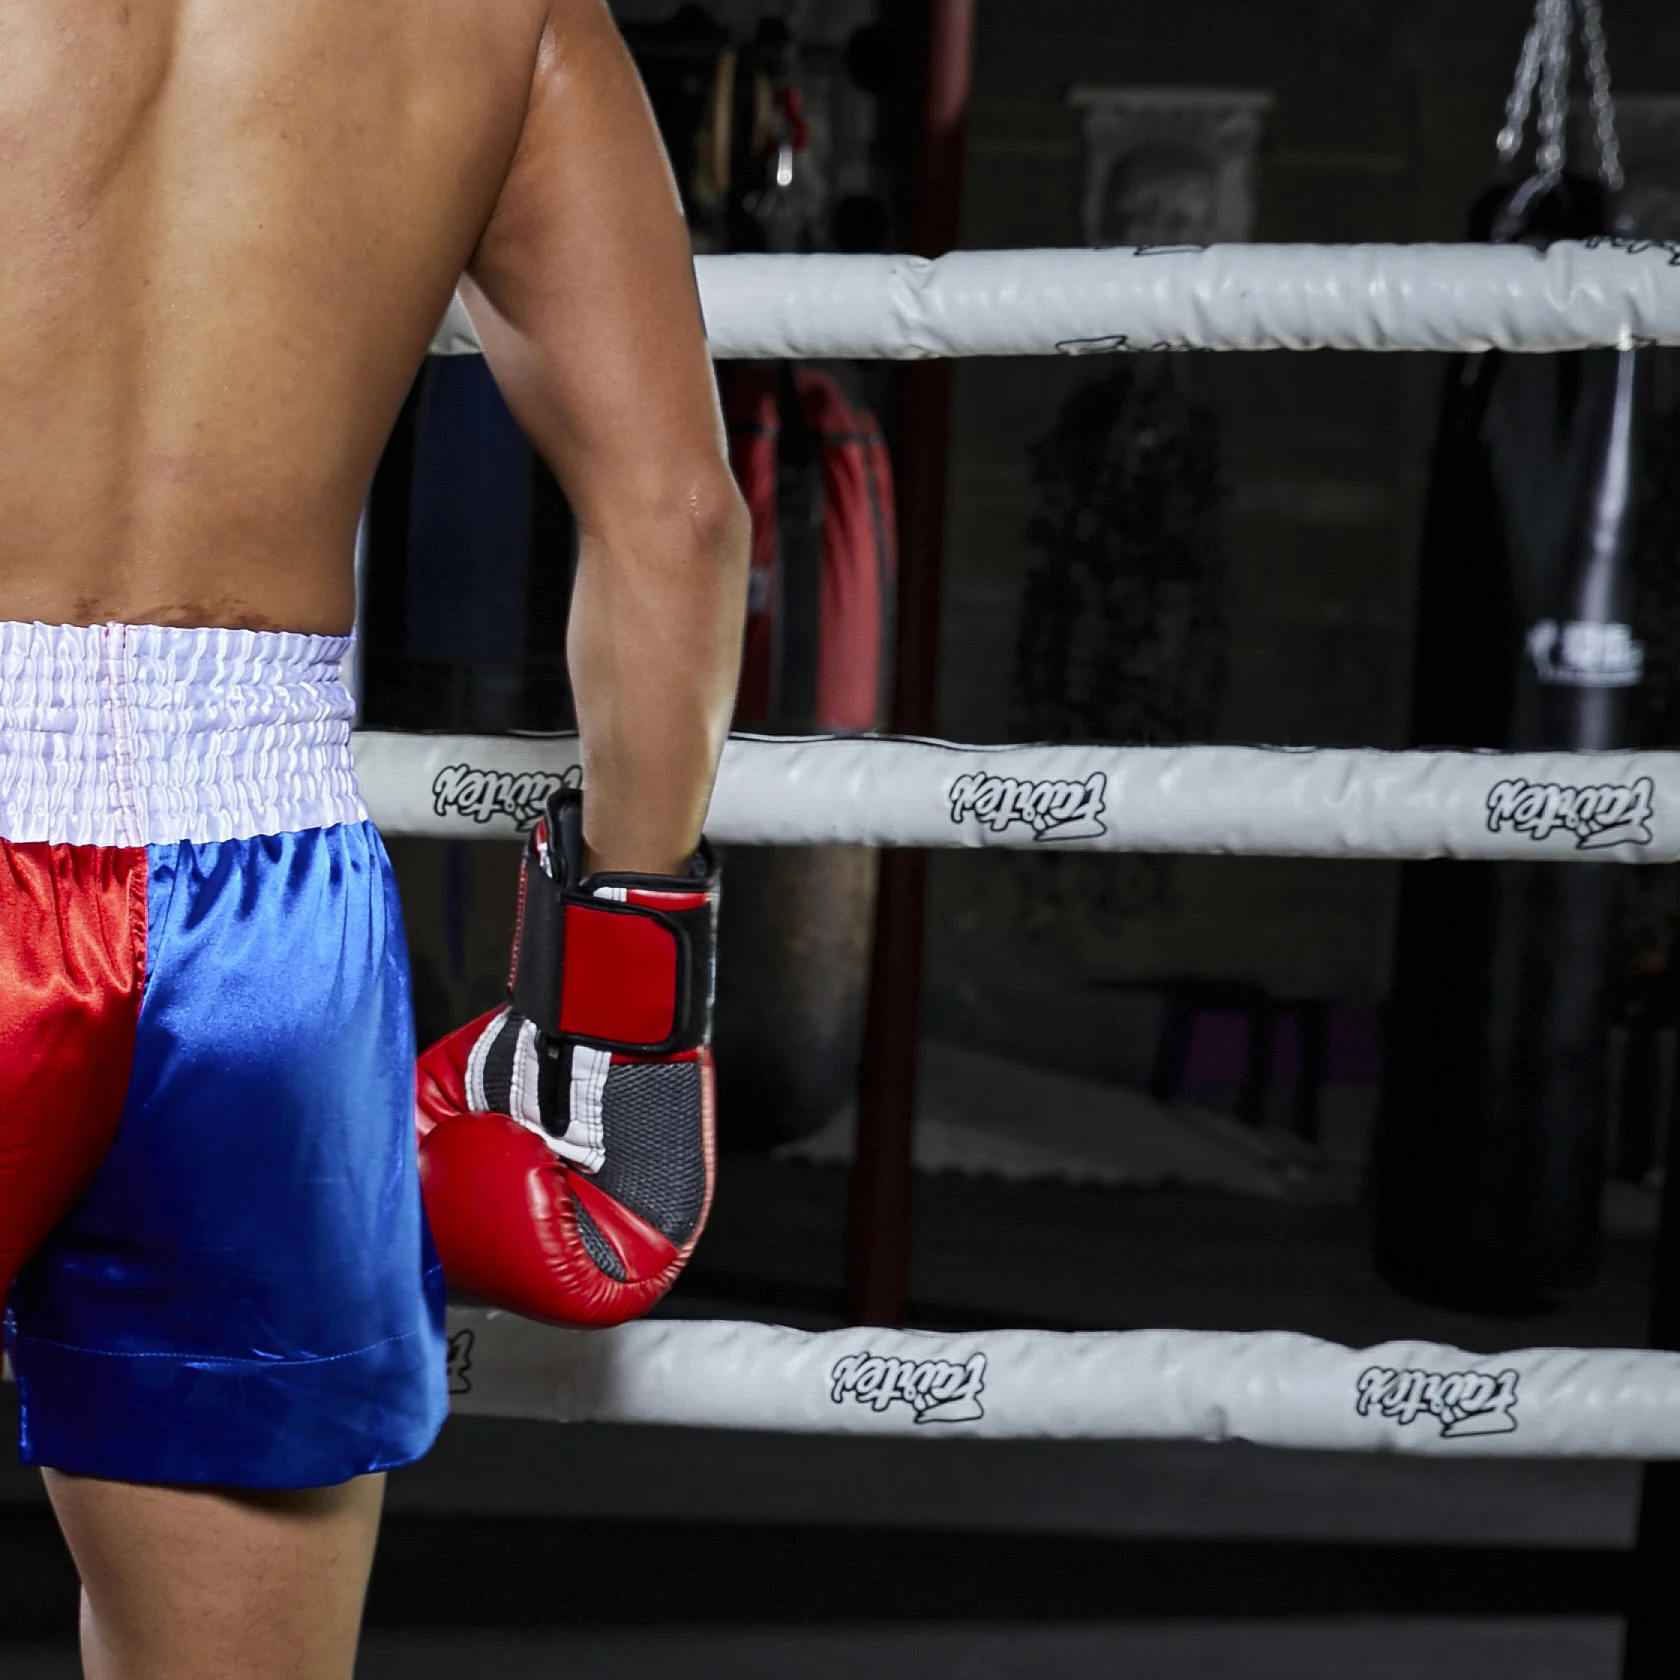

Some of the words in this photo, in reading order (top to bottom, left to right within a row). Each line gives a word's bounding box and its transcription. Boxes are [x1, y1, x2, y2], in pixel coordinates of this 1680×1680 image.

[949, 771, 1108, 843] Fairtex
[1487, 776, 1654, 851] Fairtex
[831, 1351, 987, 1425] Fairtex
[1356, 1366, 1519, 1439] Fairtex
